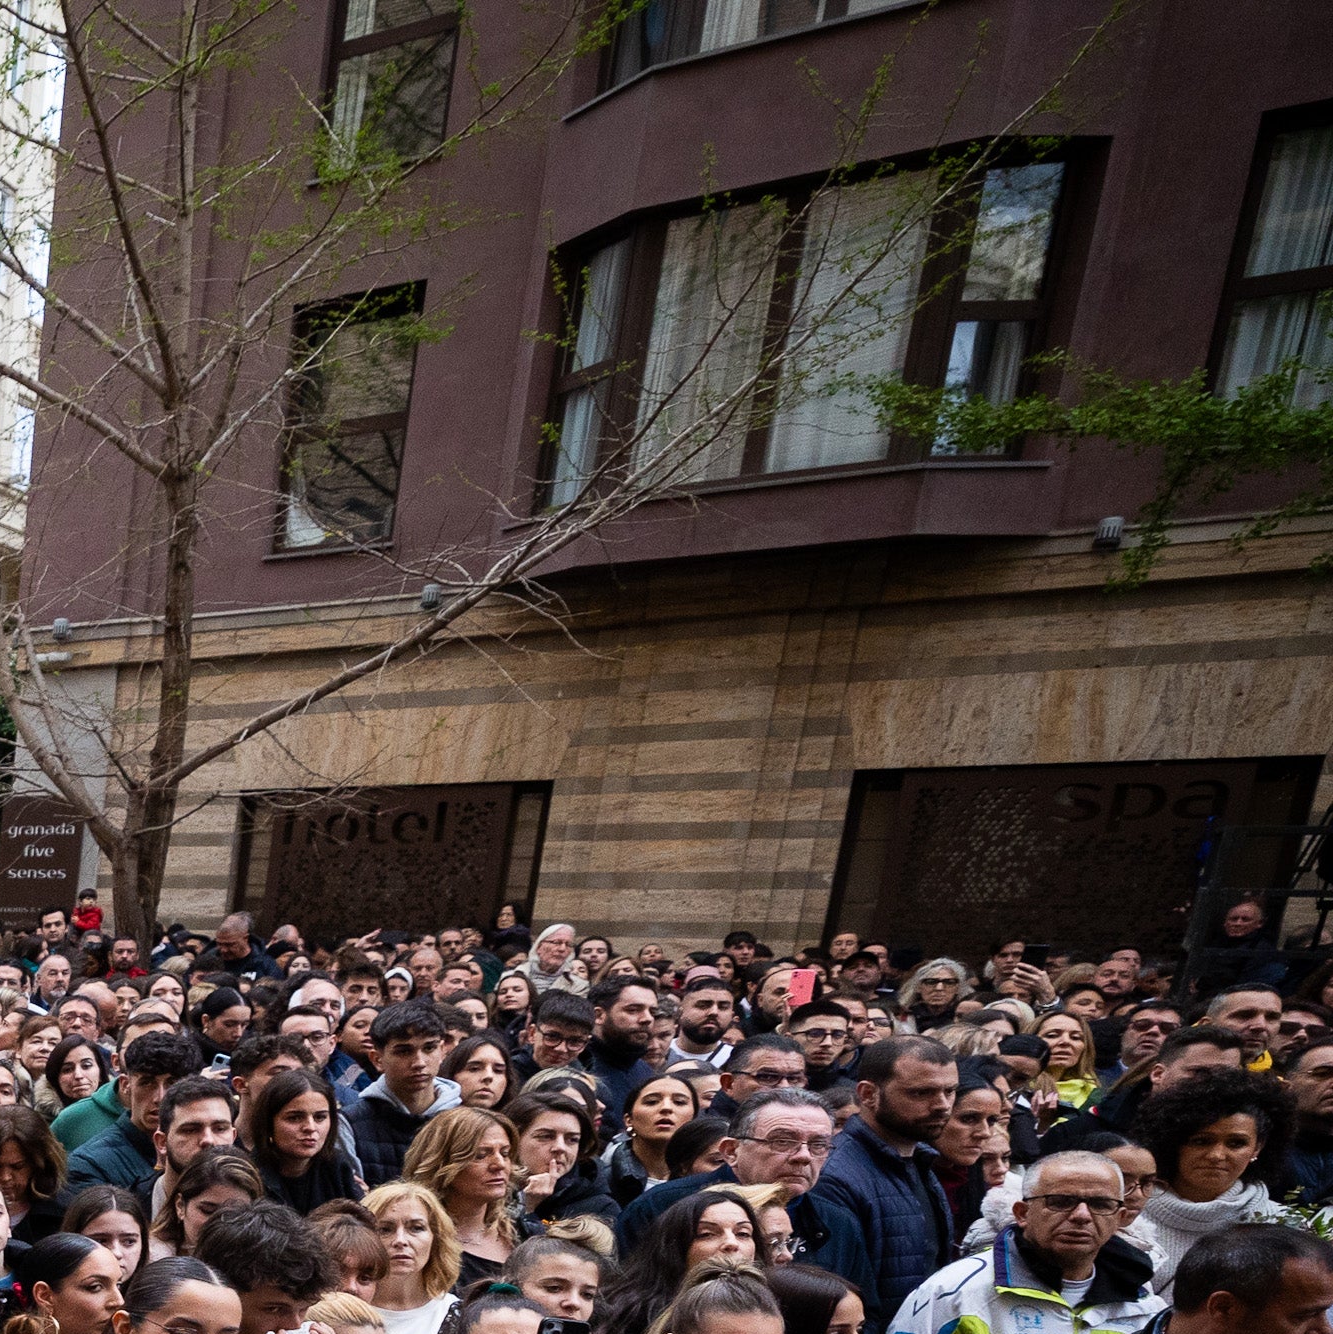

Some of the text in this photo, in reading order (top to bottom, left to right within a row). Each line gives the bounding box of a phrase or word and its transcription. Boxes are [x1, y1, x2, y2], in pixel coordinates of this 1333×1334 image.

[1051, 780, 1230, 833] spa
[8, 823, 76, 839] granada
[282, 801, 448, 845] hotel
[23, 844, 55, 857] five
[7, 868, 67, 879] senses
